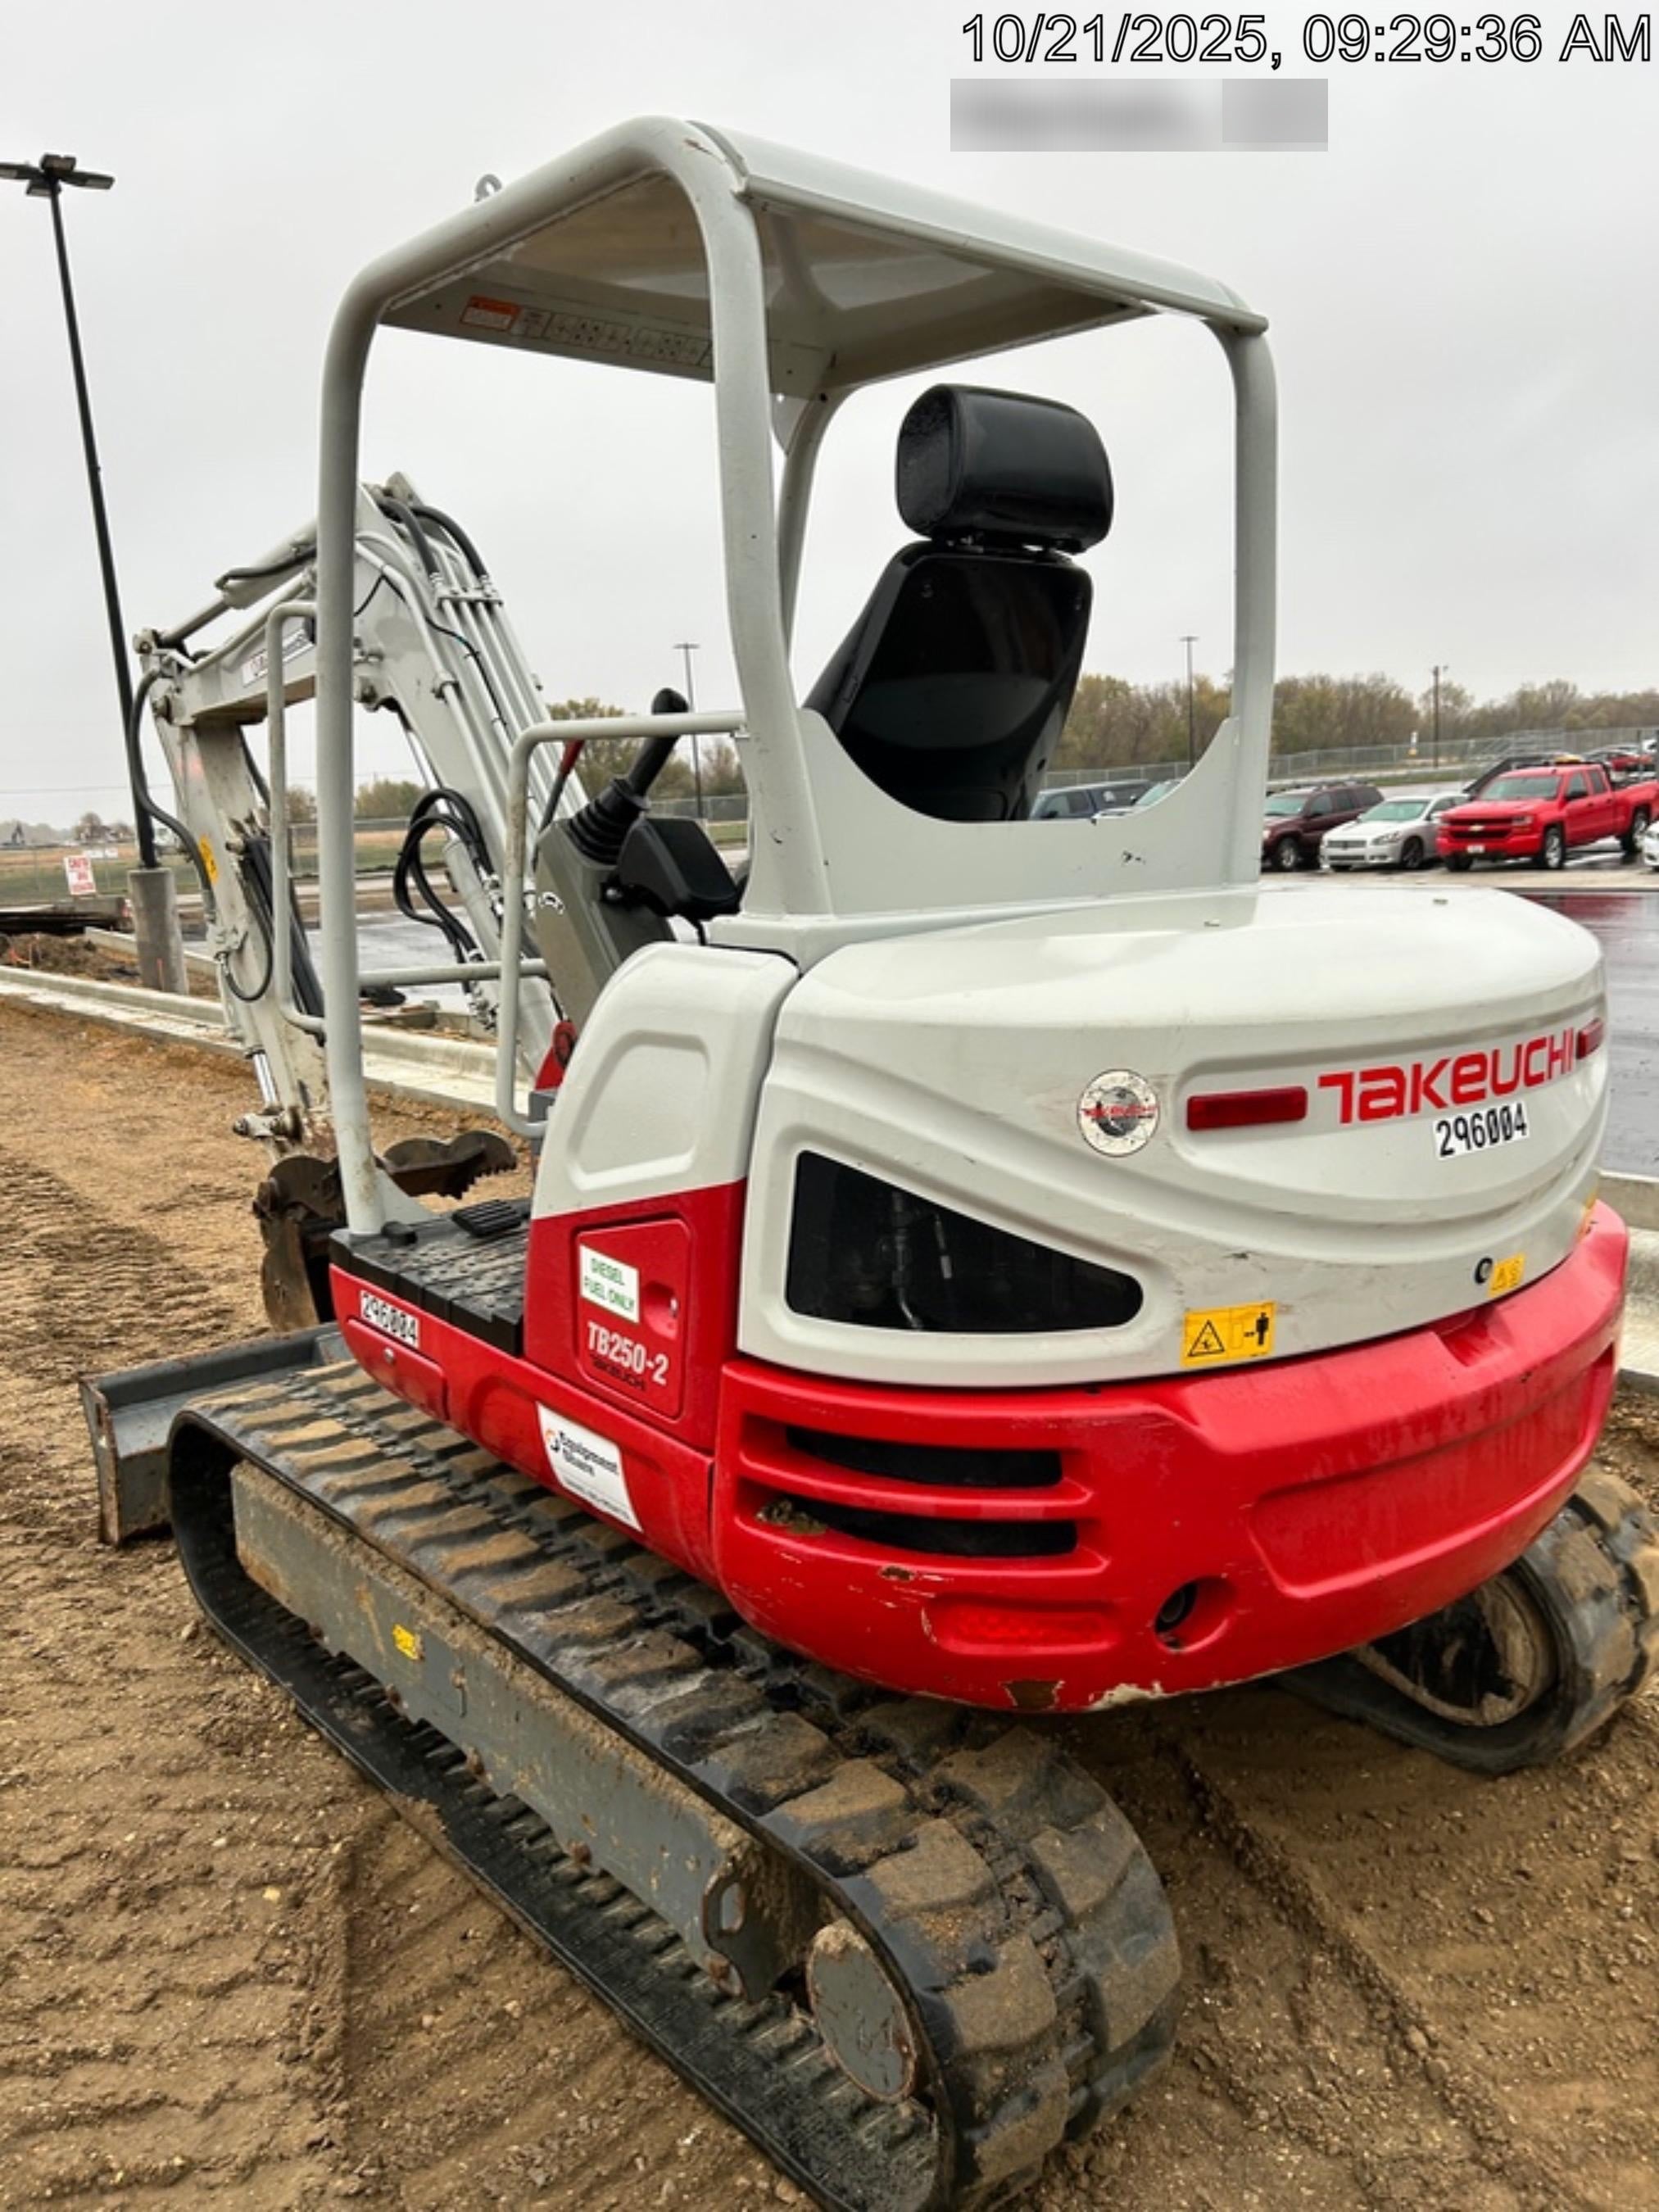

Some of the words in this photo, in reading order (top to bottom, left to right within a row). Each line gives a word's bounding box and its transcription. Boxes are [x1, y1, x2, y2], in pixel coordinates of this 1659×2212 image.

[1317, 1027, 1574, 1125] TAKEUCHI
[1436, 1103, 1527, 1157] 296004
[362, 1292, 416, 1344] 296004
[587, 1320, 669, 1386] TB250-2
